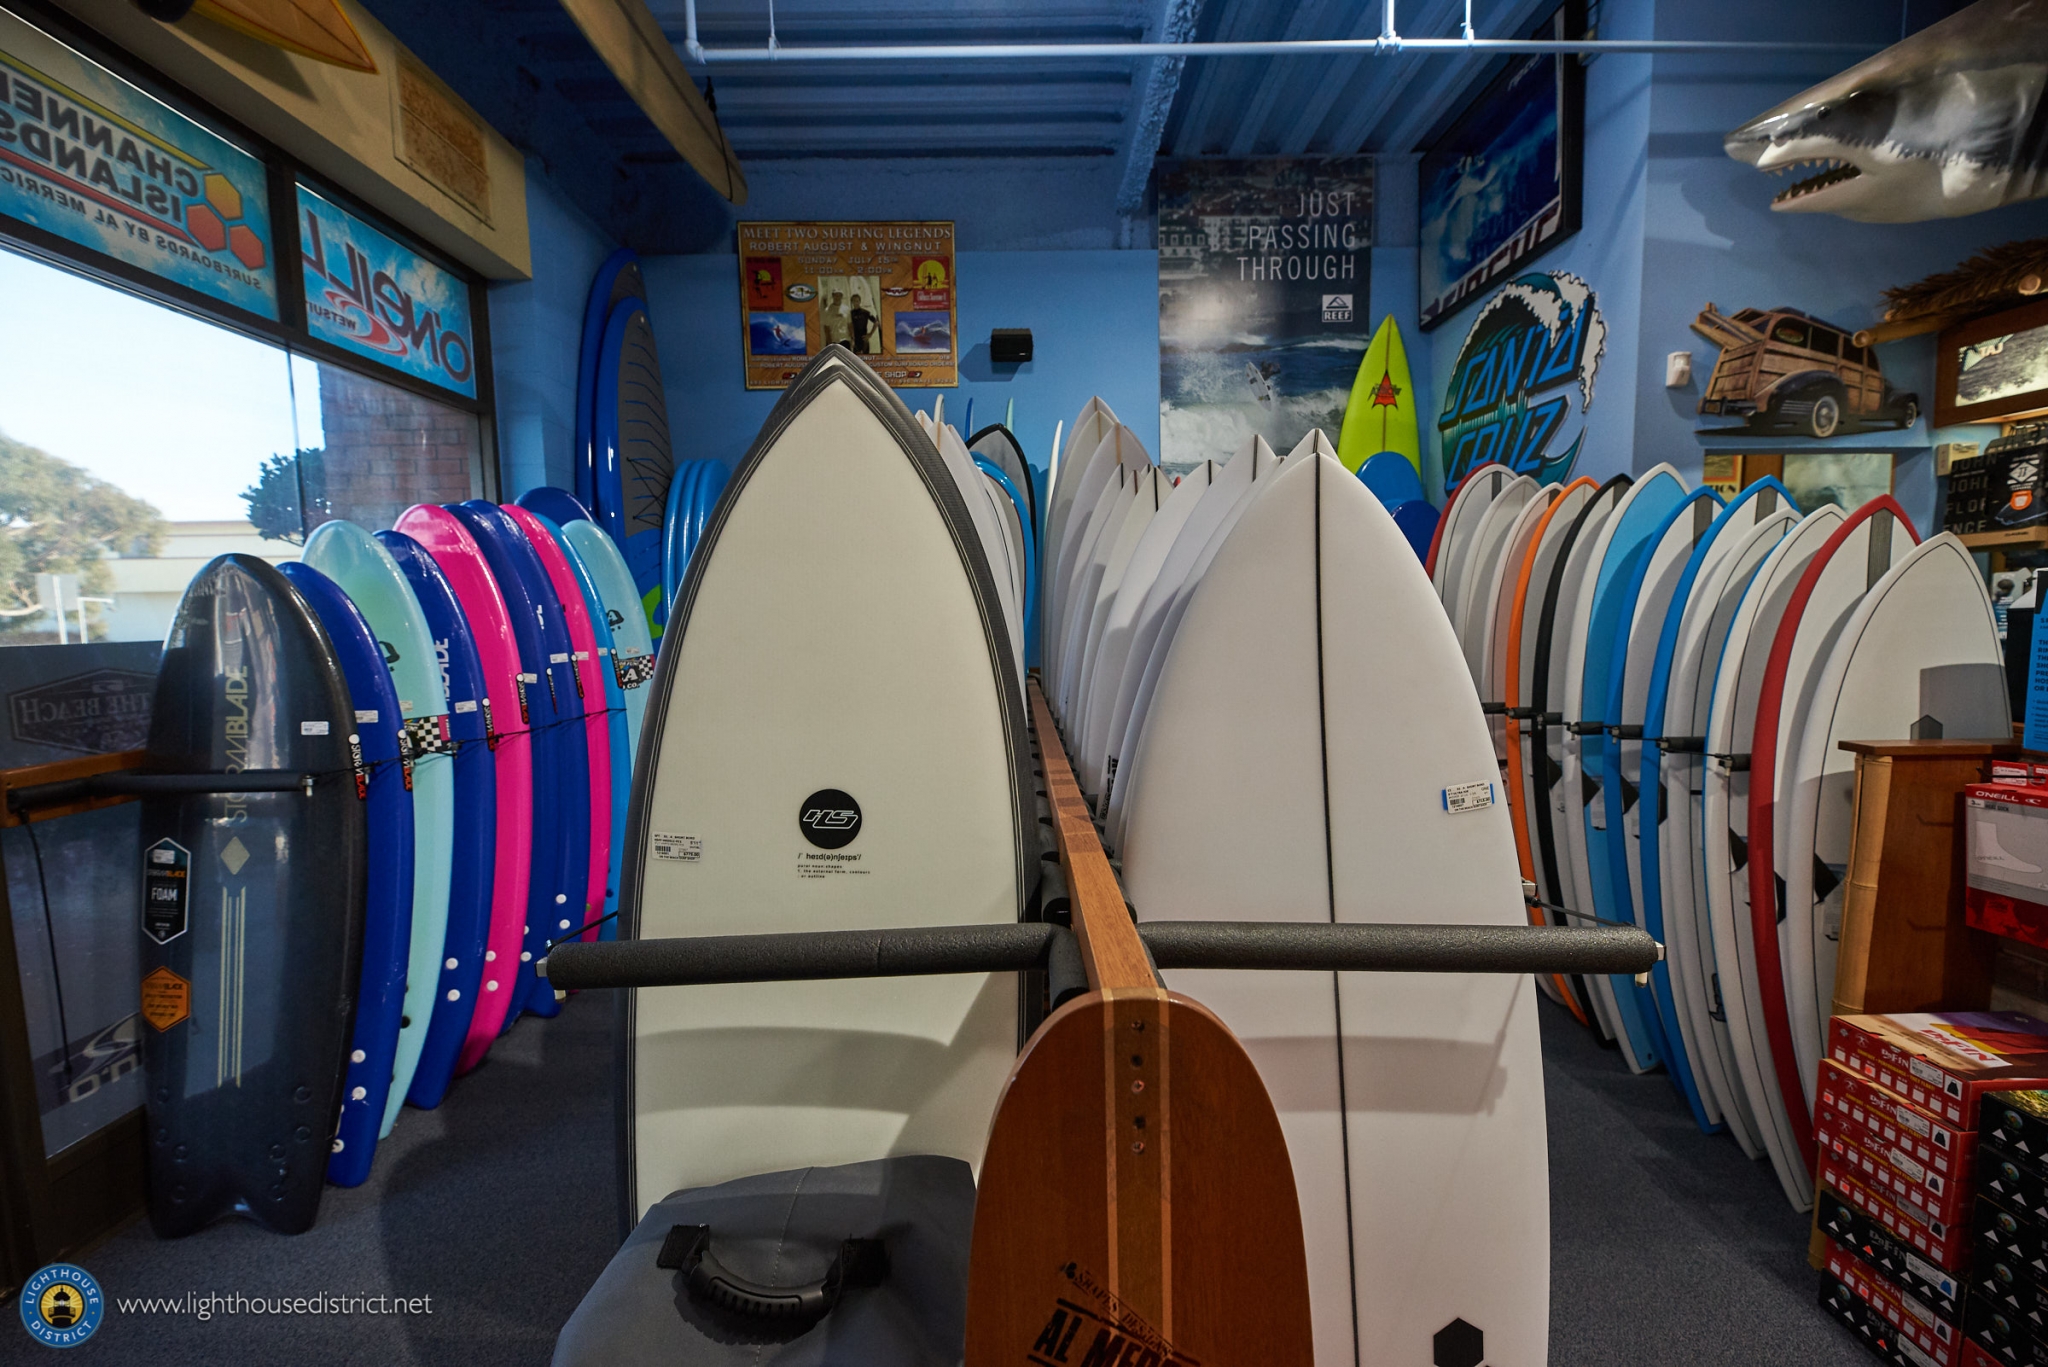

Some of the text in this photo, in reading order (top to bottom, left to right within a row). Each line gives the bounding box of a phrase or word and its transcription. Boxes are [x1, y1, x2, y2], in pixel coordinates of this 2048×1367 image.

[1297, 191, 1355, 217] JUST
[743, 227, 951, 239] MEET TWO SURFING LEGENDS
[1249, 223, 1356, 250] PASSING
[749, 241, 941, 252] ROBERT AUGUST & WINGNUT
[798, 256, 839, 265] SUNDAY
[848, 256, 873, 265] JULY
[1236, 254, 1355, 281] THROUGH
[1323, 311, 1351, 321] REEF
[1438, 296, 1591, 424] SANTA
[1445, 397, 1564, 492] CRUZ
[151, 887, 178, 901] FOAM
[1033, 1308, 1084, 1364] AL
